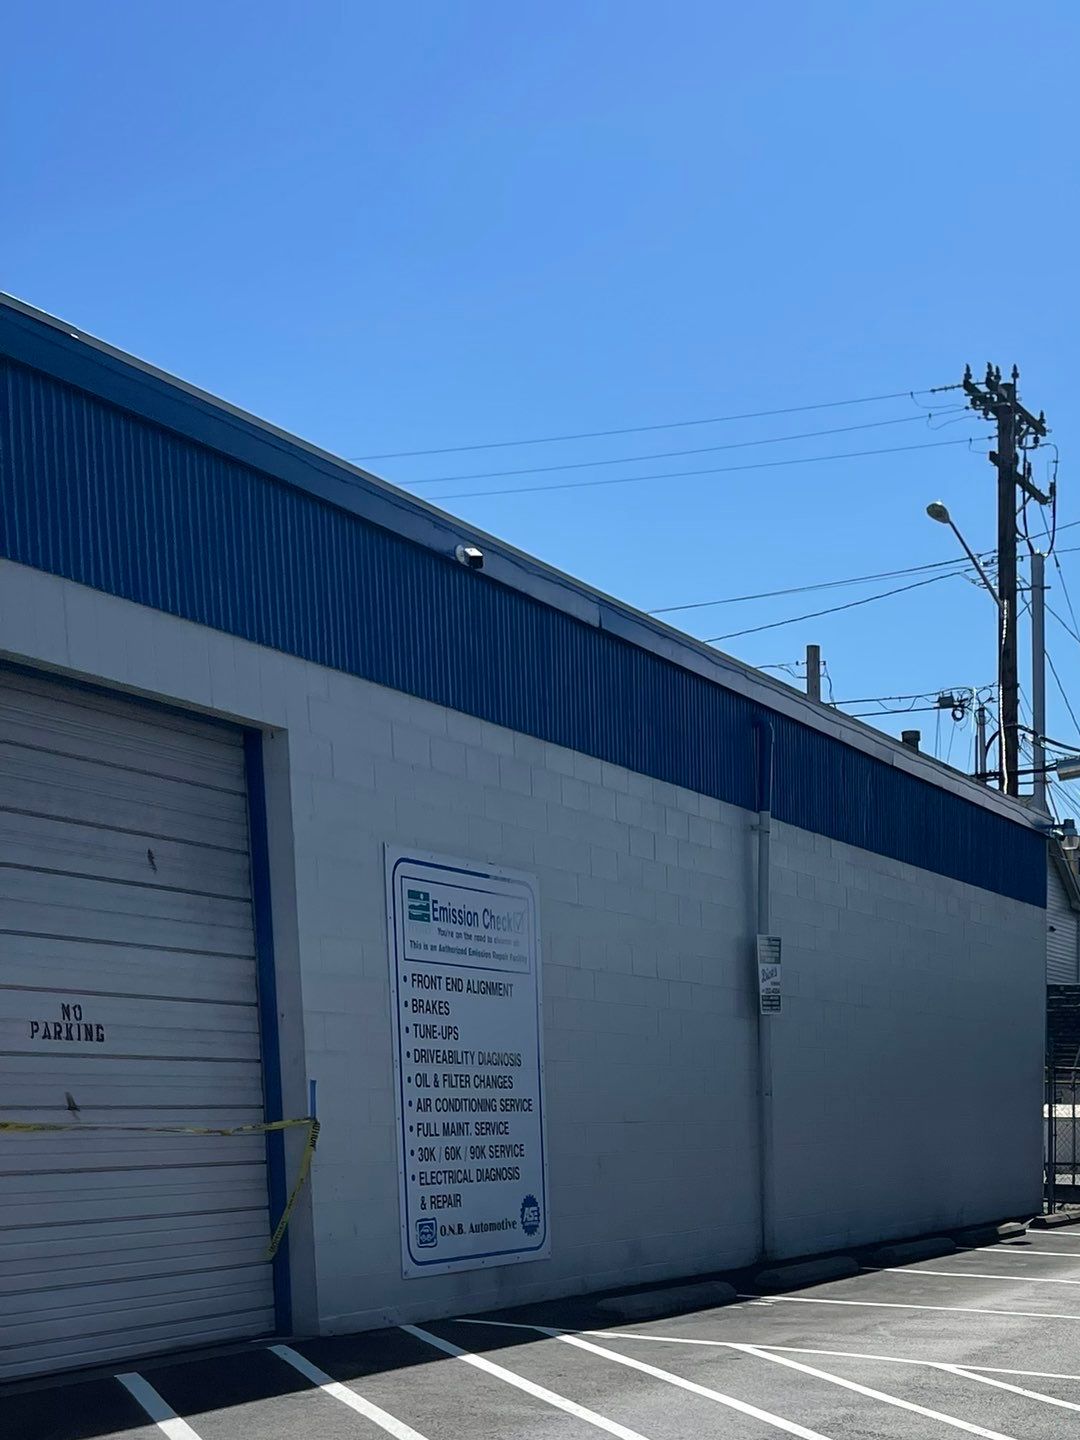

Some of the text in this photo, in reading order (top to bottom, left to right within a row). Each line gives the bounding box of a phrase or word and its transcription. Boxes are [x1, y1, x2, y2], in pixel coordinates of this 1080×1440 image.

[432, 900, 479, 928] Emission
[482, 908, 514, 932] Check
[455, 931, 463, 939] on
[464, 932, 472, 941] the
[409, 939, 422, 949] This
[430, 944, 437, 952] an
[439, 943, 467, 956] Authorized
[468, 947, 492, 959] Emission
[411, 972, 514, 997] FRONT END ALIGNMENT
[60, 1002, 83, 1022] NO
[411, 998, 450, 1016] BRAKES
[30, 1021, 105, 1042] PARKING
[413, 1023, 459, 1041] TUNE-UPS
[413, 1048, 522, 1067] DRIVEABILITY DIAGNOSIS
[415, 1073, 514, 1090] OIL & FILTER CHANGES
[416, 1097, 533, 1113] AIR CONDITIONING SERVICE
[417, 1121, 510, 1138] FULL MAINT. SERVICE
[418, 1147, 436, 1162] 30K
[445, 1145, 462, 1161] 60K
[470, 1144, 487, 1160] 90K
[488, 1143, 525, 1159] SERVICE
[418, 1166, 521, 1187] ELECTRICAL DIAGNOSIS
[420, 1193, 462, 1210] & REPAIR
[469, 1218, 518, 1235] Automotive
